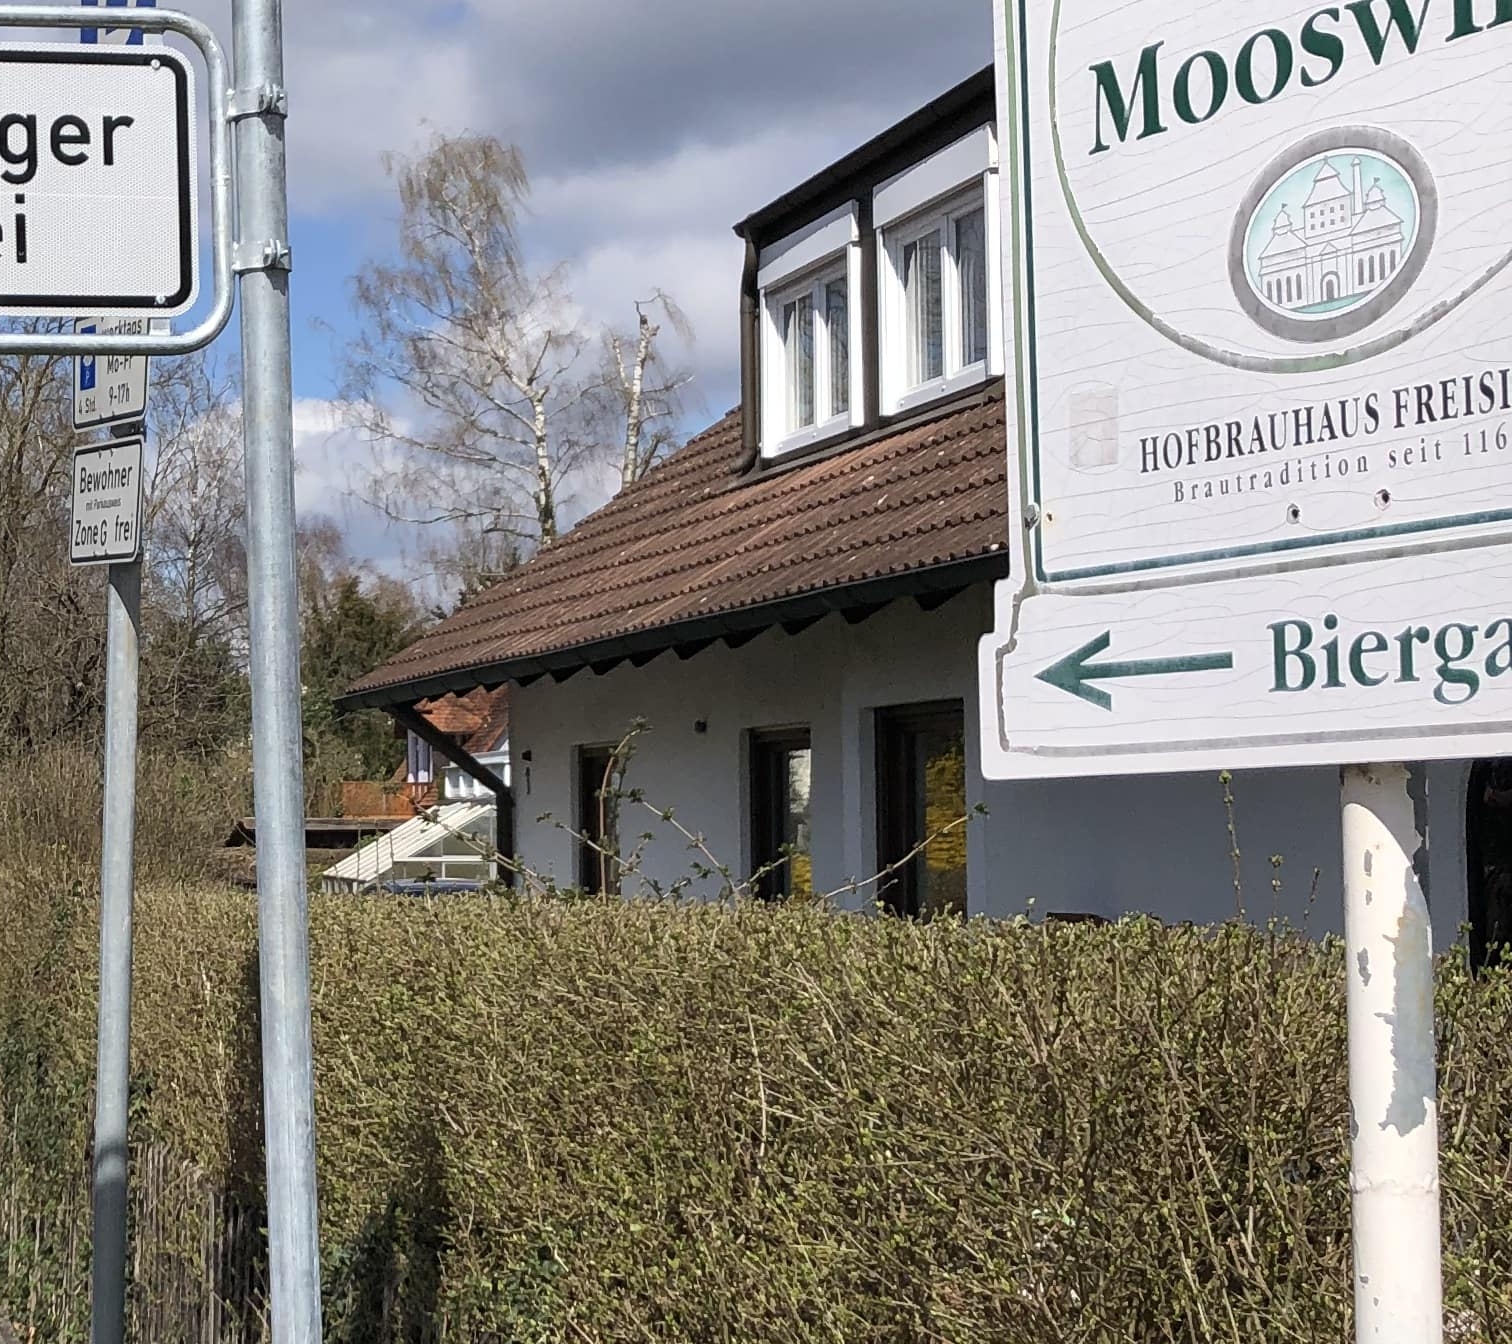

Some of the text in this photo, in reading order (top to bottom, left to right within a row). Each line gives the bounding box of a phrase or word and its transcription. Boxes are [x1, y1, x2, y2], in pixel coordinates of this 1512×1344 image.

[1139, 368, 1511, 474] HOFBRAUHAUS FREISI
[80, 462, 133, 493] Bewohner
[1174, 421, 1508, 502] Brautradition seit 116
[75, 513, 134, 546] Zone G frei
